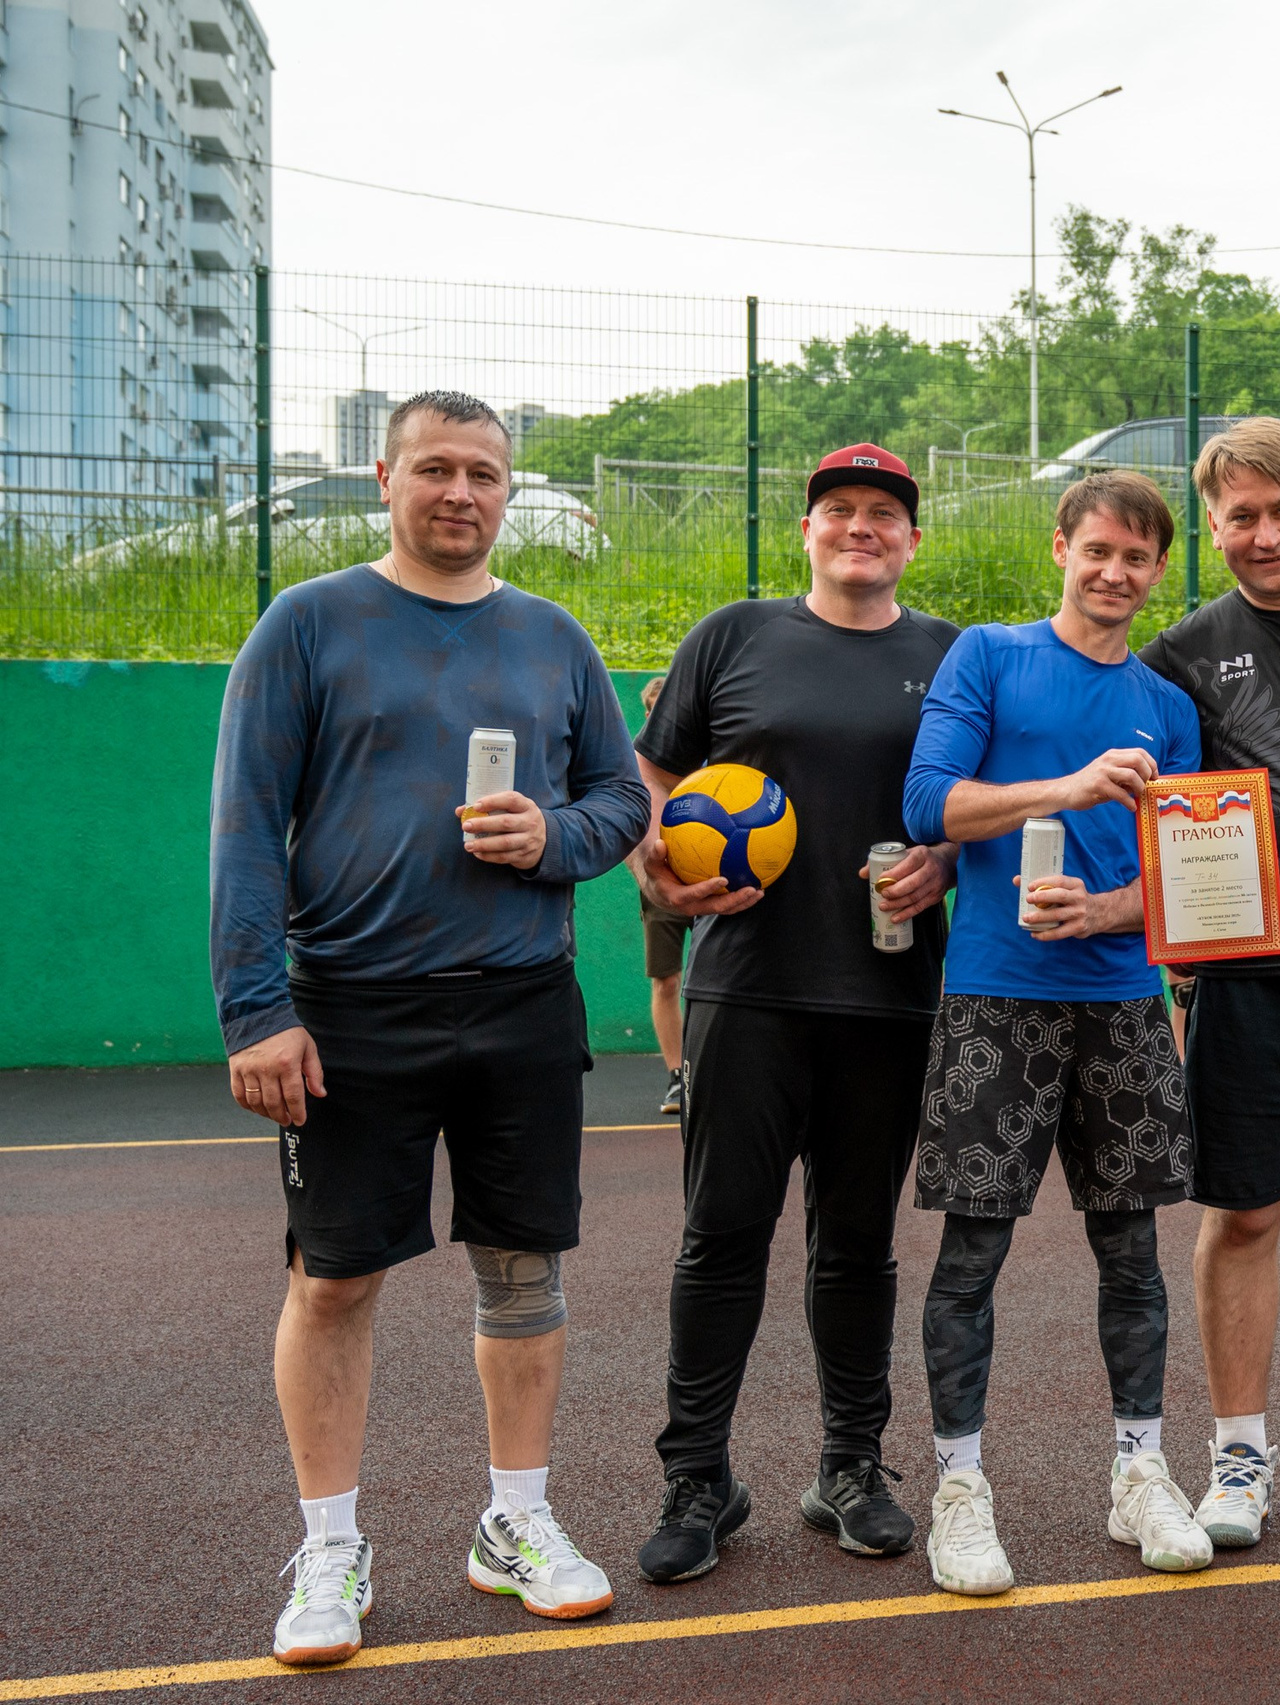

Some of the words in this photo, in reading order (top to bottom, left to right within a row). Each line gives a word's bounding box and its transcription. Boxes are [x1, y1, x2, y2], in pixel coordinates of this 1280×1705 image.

[1221, 668, 1255, 683] SPORT
[1172, 825, 1245, 842] ГРАМОТА
[1181, 853, 1239, 864] НАГРАЖДАЕТСЯ
